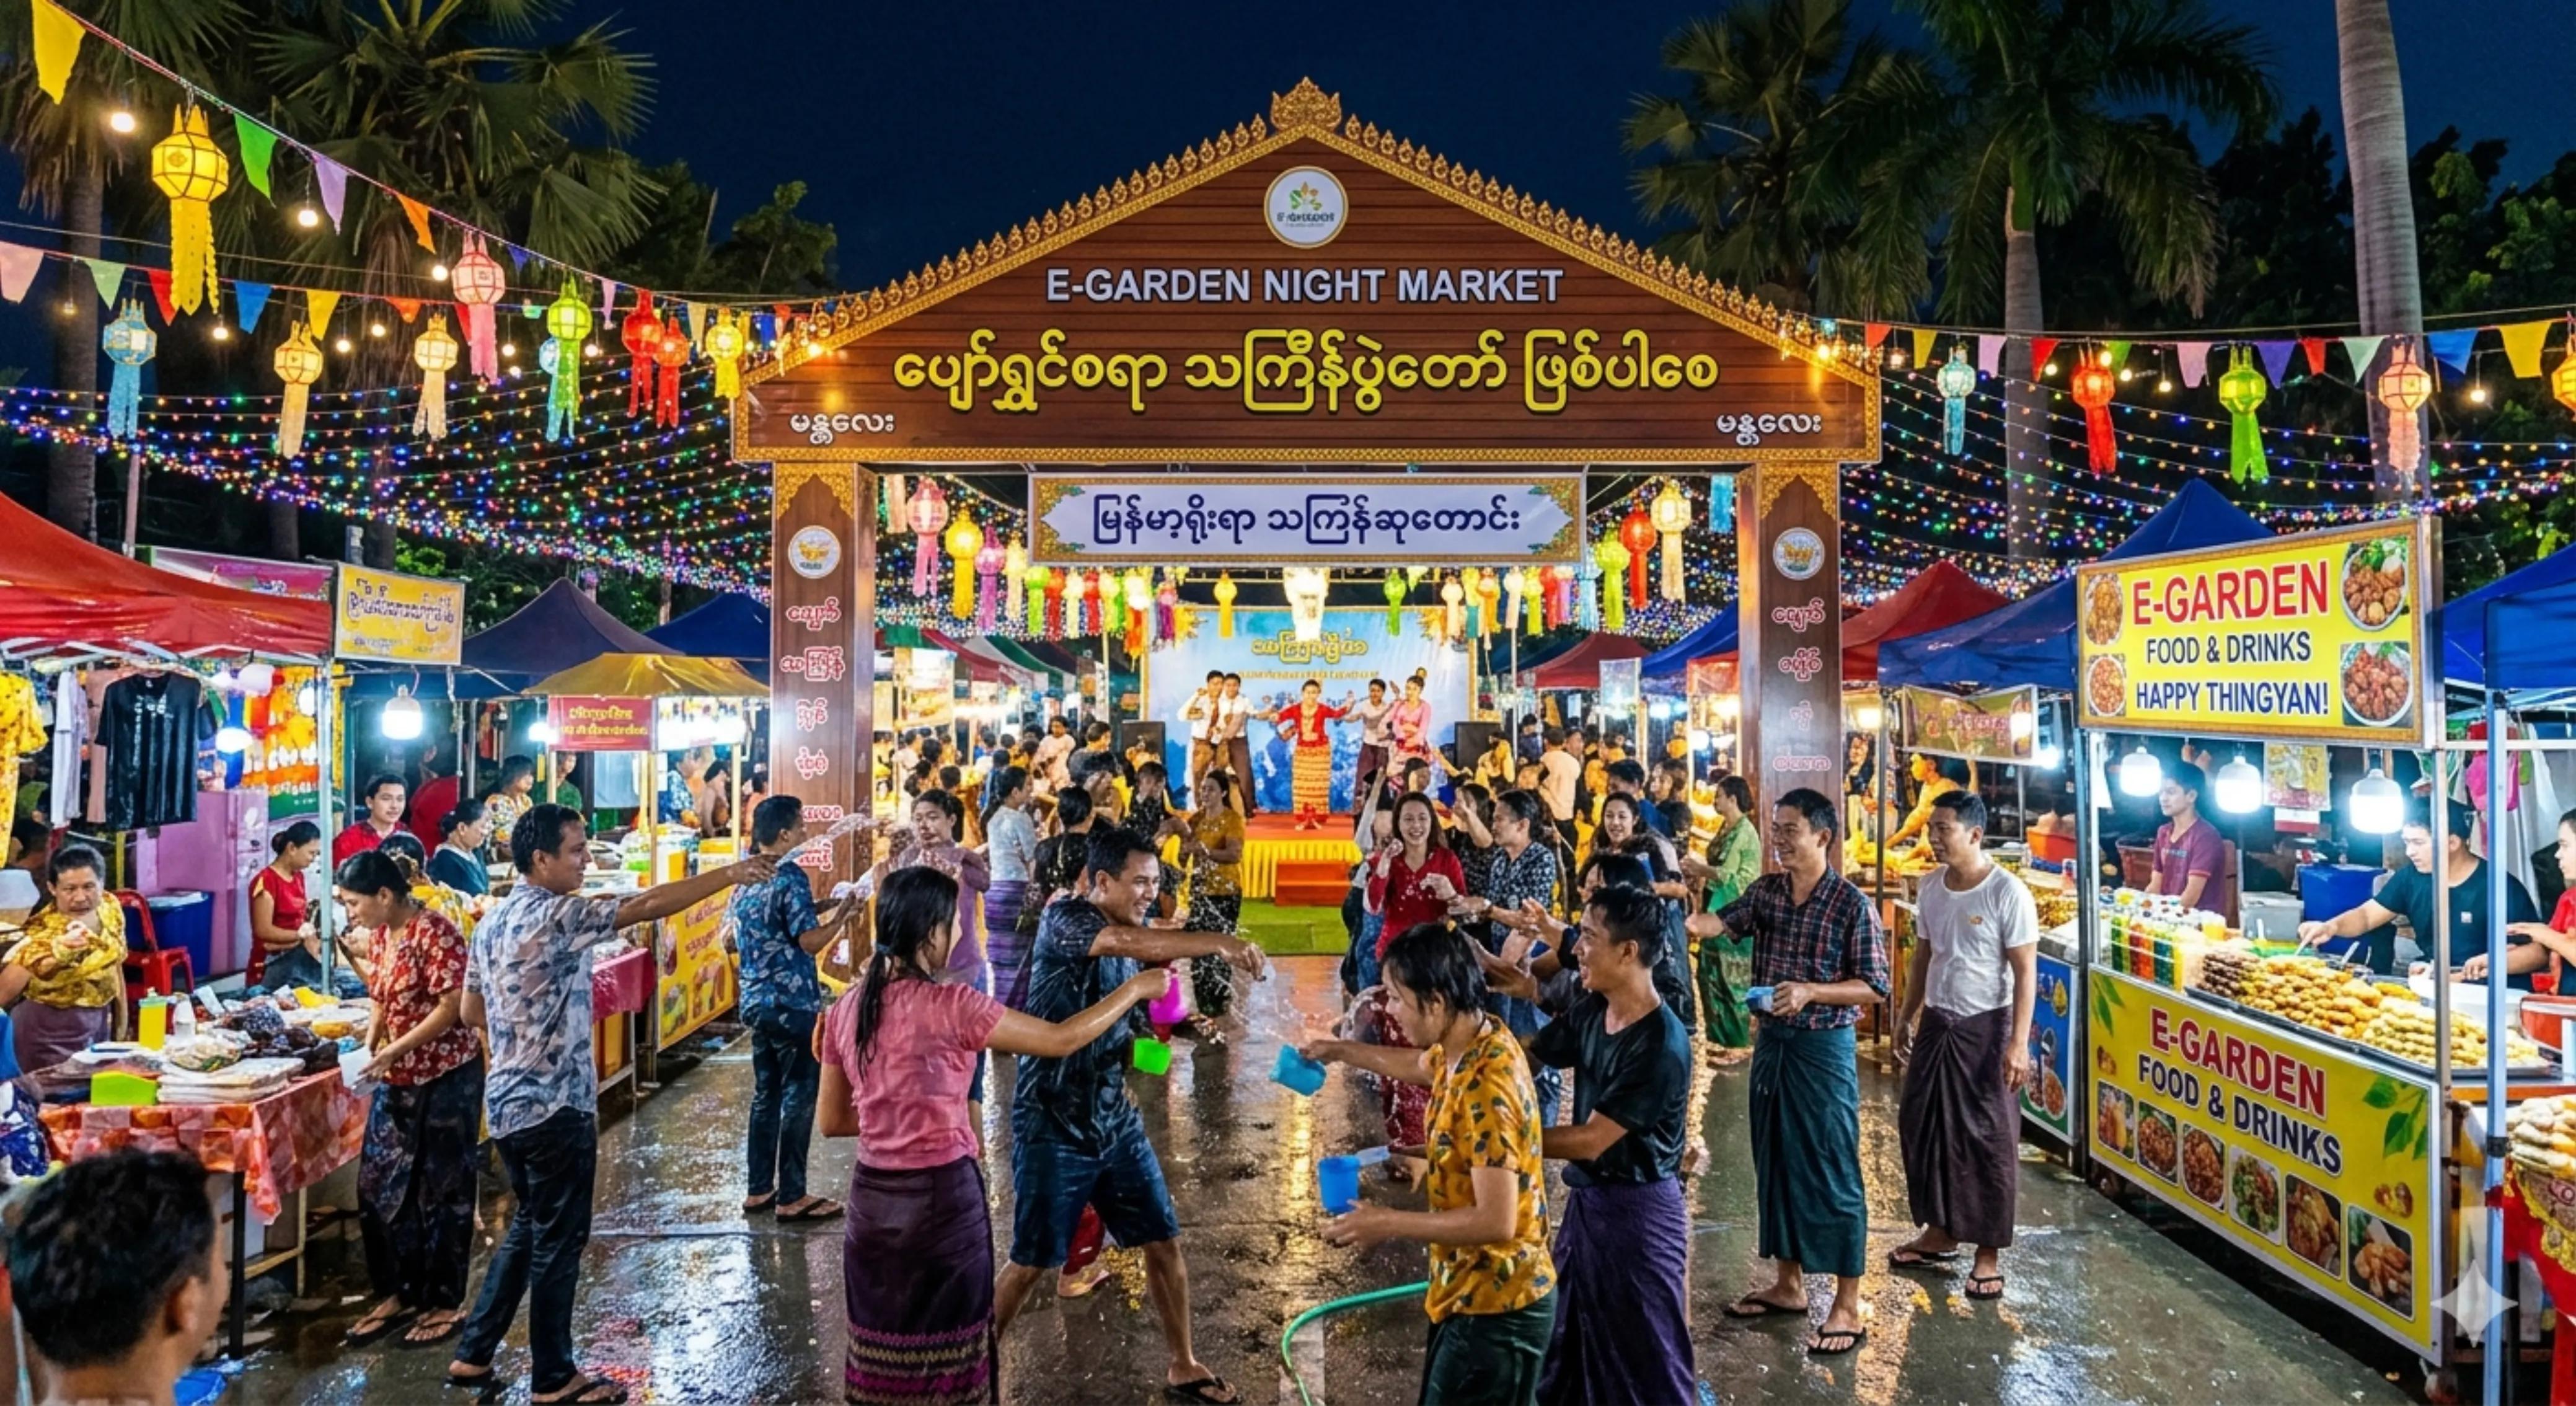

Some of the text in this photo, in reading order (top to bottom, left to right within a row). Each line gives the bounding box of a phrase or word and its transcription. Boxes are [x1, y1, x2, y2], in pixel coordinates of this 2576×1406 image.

[1046, 267, 1564, 303] E-GARDEN NIGHT MARKET
[1525, 328, 1719, 412] ဖြစ်ပါစေ
[2133, 561, 2328, 624] E-GARDEN
[2147, 631, 2311, 664] FOOD & DRINKS
[2137, 682, 2329, 715] HAPPY THINGYAN!
[2151, 1008, 2326, 1117] E-GARDEN
[2139, 1054, 2342, 1174] FOOD & DRINKS
